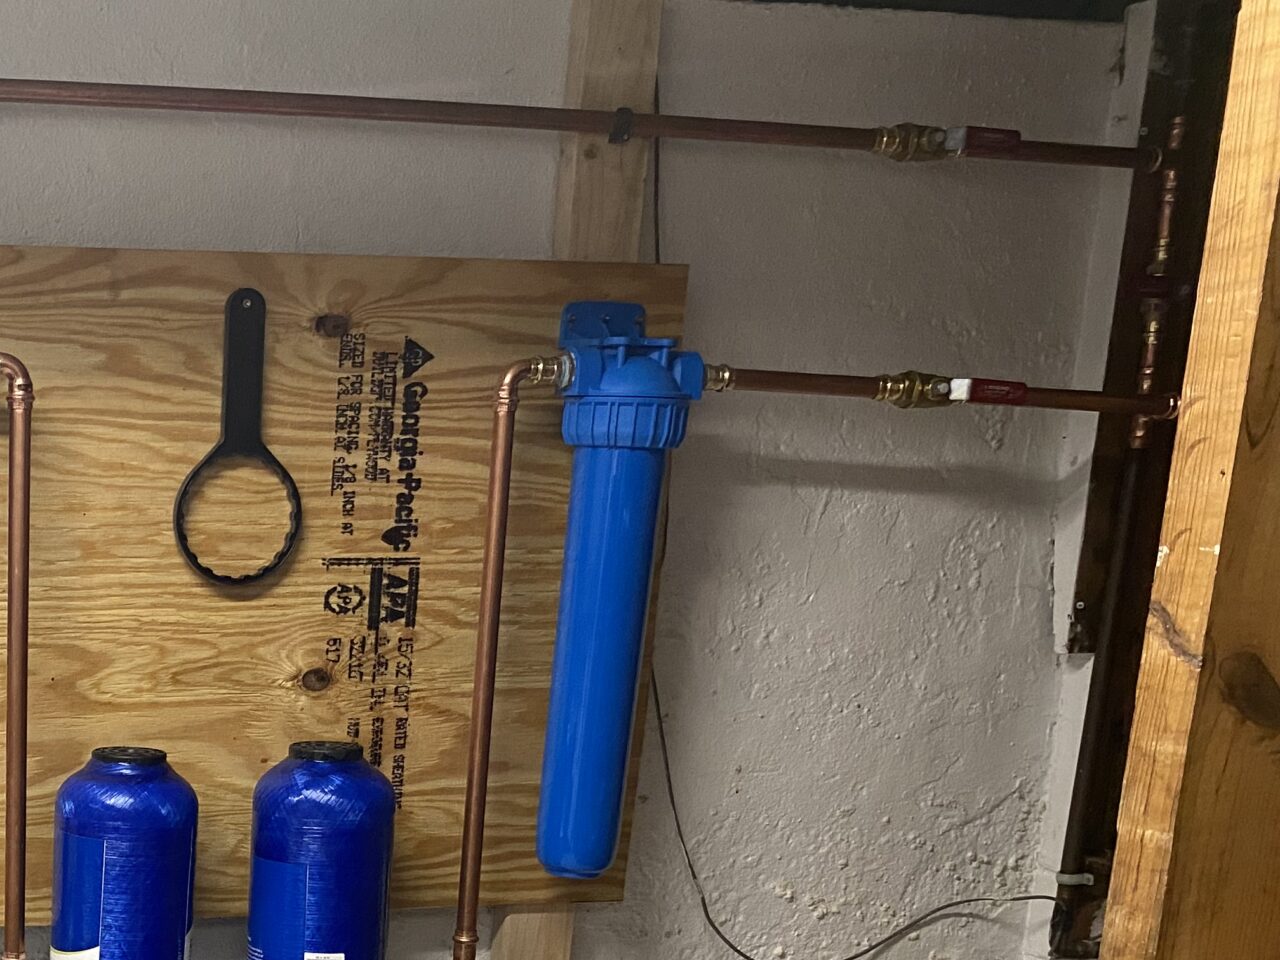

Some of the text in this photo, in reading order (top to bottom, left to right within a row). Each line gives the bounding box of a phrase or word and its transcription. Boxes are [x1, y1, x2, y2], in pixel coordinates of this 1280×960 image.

[352, 333, 366, 368] SIZED
[349, 374, 363, 395] FOR
[382, 352, 399, 400] LIMITED
[334, 436, 346, 451] AT
[376, 468, 390, 484] AT
[393, 382, 429, 552] Georgia-Pacific
[341, 490, 355, 517] INCH
[340, 522, 354, 536] AT
[379, 574, 409, 623] APA
[395, 637, 414, 680] 15/32
[393, 685, 411, 712] CAT
[394, 717, 409, 750] RATED
